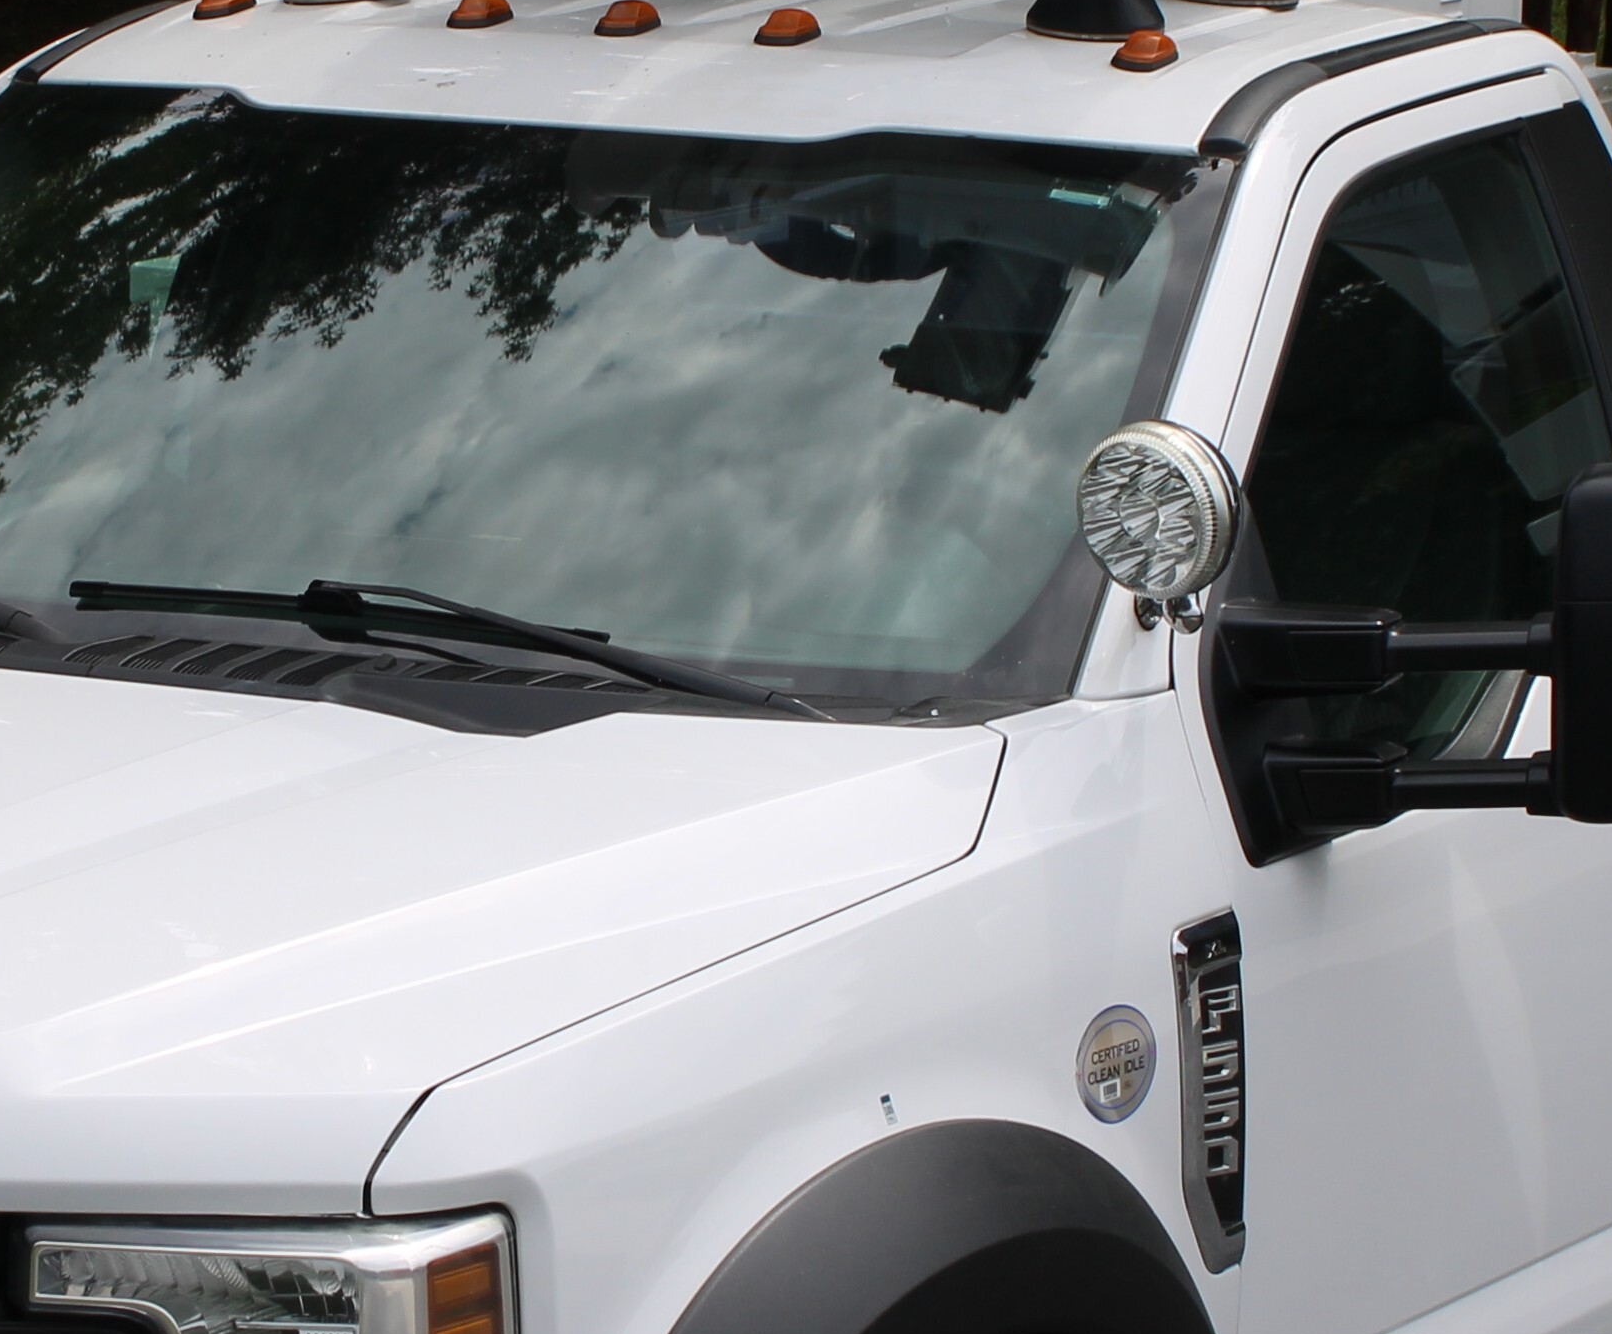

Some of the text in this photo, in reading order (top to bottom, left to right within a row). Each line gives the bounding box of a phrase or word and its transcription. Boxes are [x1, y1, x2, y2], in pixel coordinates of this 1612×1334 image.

[1091, 1038, 1140, 1065] CERTIFIED
[1087, 1055, 1146, 1086] CLEAN IDLE
[1199, 984, 1239, 1174] F550
